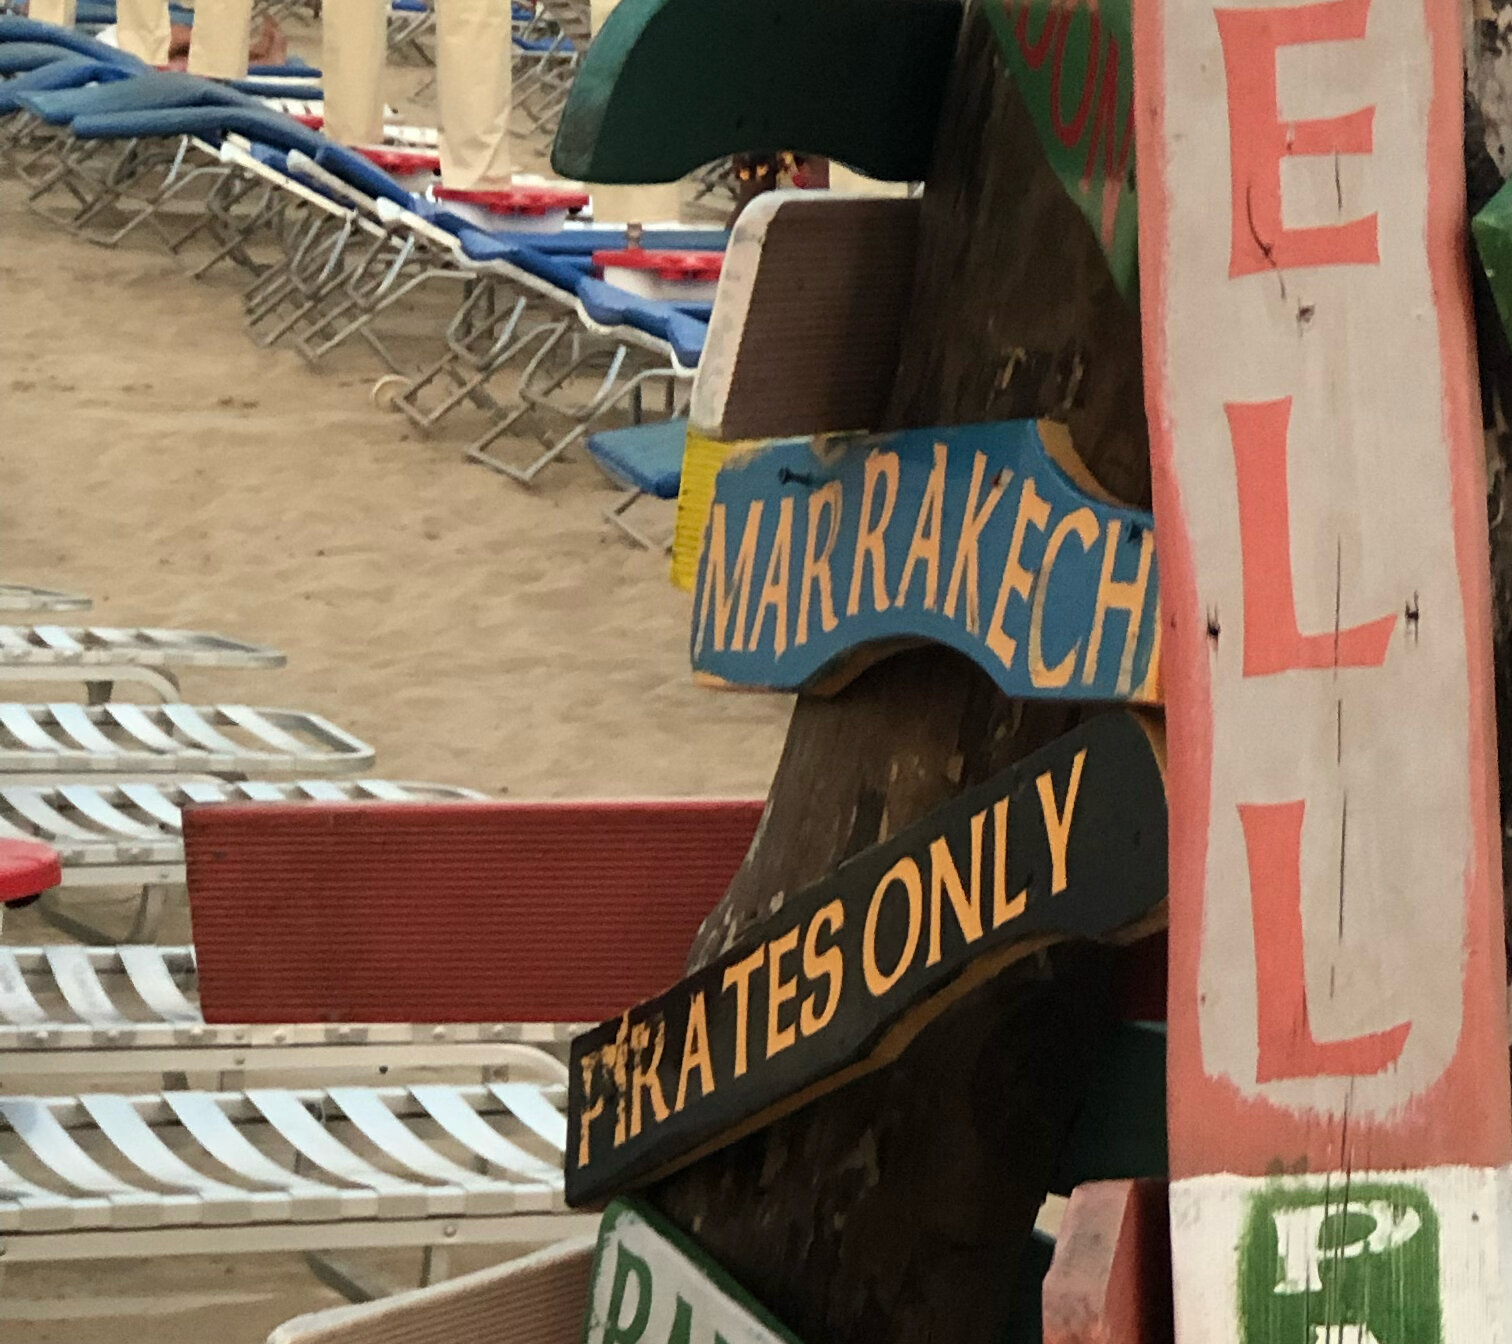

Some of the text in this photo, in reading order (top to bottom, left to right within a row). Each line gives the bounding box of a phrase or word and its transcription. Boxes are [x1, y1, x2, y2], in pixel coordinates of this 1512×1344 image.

[694, 442, 1154, 696] MARRAKECH
[577, 747, 1088, 1171] PIRATES ONLY
